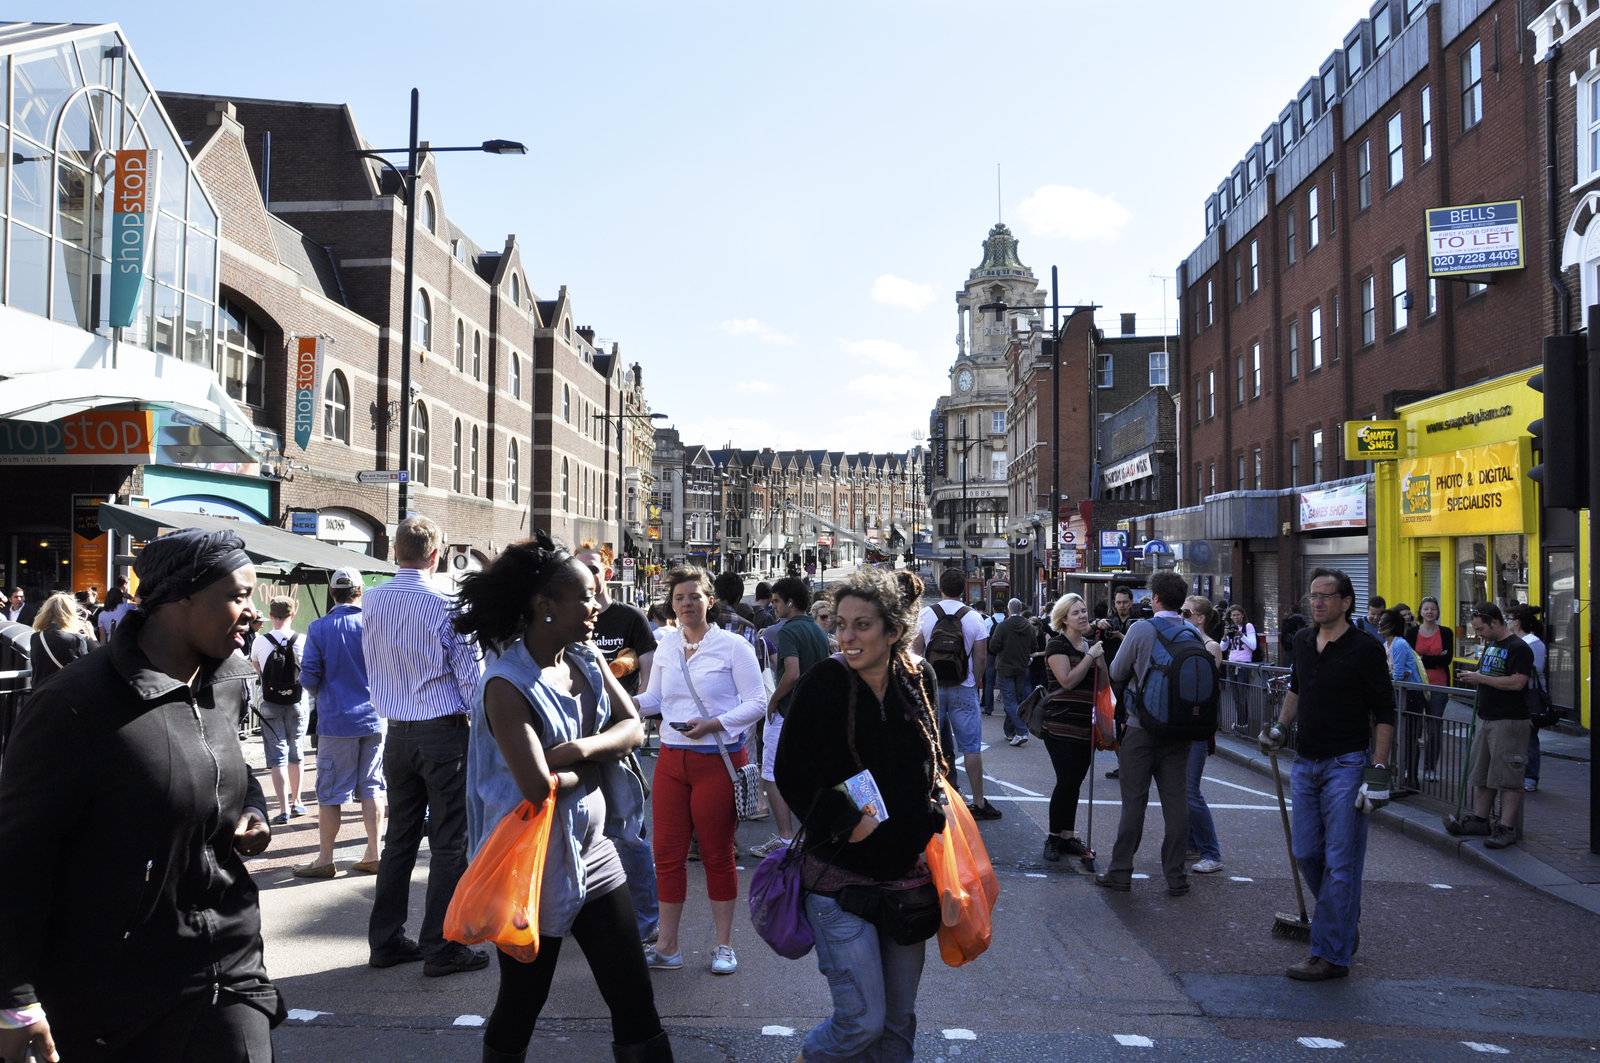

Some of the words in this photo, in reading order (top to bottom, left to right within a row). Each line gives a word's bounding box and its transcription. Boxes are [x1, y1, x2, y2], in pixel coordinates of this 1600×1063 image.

[117, 157, 146, 274] shopstop
[1450, 206, 1496, 223] BELLS
[1434, 236, 1465, 249] TO
[1473, 231, 1514, 246] LET
[1438, 229, 1457, 237] FIRST
[1458, 228, 1480, 236] FLOOR
[1434, 255, 1455, 267] 020
[1458, 253, 1486, 264] 7228
[1489, 250, 1518, 261] 4405
[1434, 261, 1518, 272] www.bellscommercial.co.uk
[295, 352, 316, 432] shopstop
[1363, 430, 1396, 443] SNAPPY
[1368, 440, 1395, 450] SNAPS
[1436, 473, 1463, 490] PHOTO
[1467, 471, 1474, 486] &
[1479, 465, 1514, 485] DIGITAL
[1446, 492, 1502, 512] SPECIALISTS
[292, 522, 317, 530] NERO
[1017, 537, 1028, 546] JD
